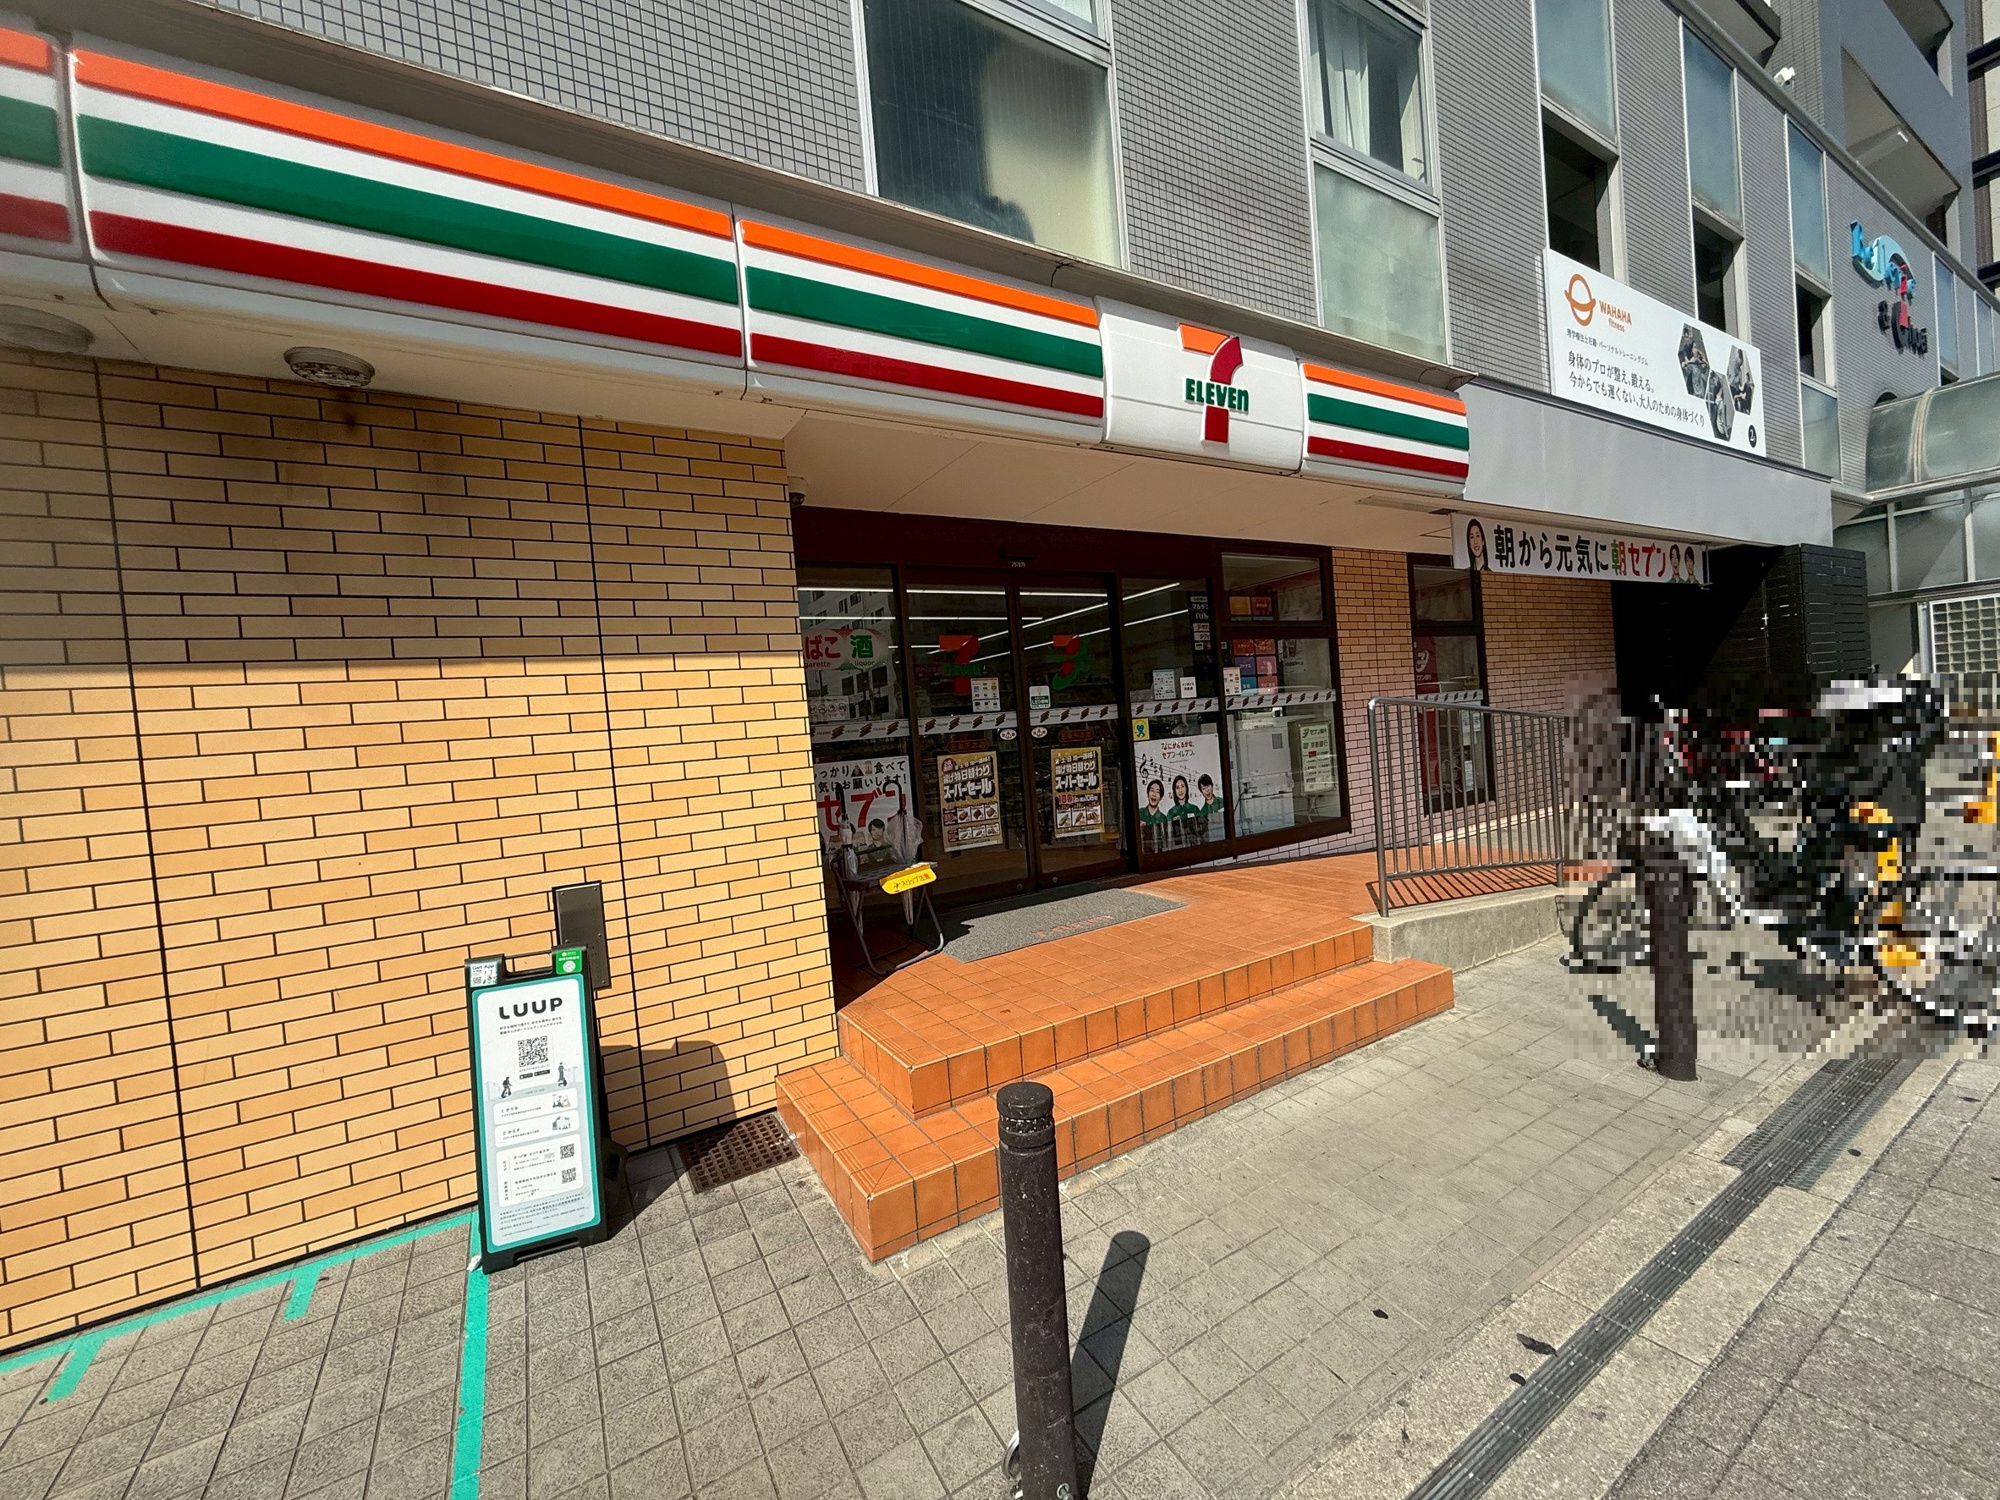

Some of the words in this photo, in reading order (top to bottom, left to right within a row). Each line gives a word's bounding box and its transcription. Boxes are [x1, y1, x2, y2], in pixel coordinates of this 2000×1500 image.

[1599, 299, 1633, 326] WAHAHA
[1568, 371, 1705, 428] 今からでも遅くない、大人のための身体づくり
[1493, 524, 1666, 578] 朝から元気に朝セブン
[850, 634, 874, 660] 酒
[854, 659, 875, 668] liquor
[813, 764, 850, 780] っかり
[874, 760, 906, 775] 食べて
[943, 777, 993, 799] スーパーセール
[498, 997, 563, 1020] LUUP
